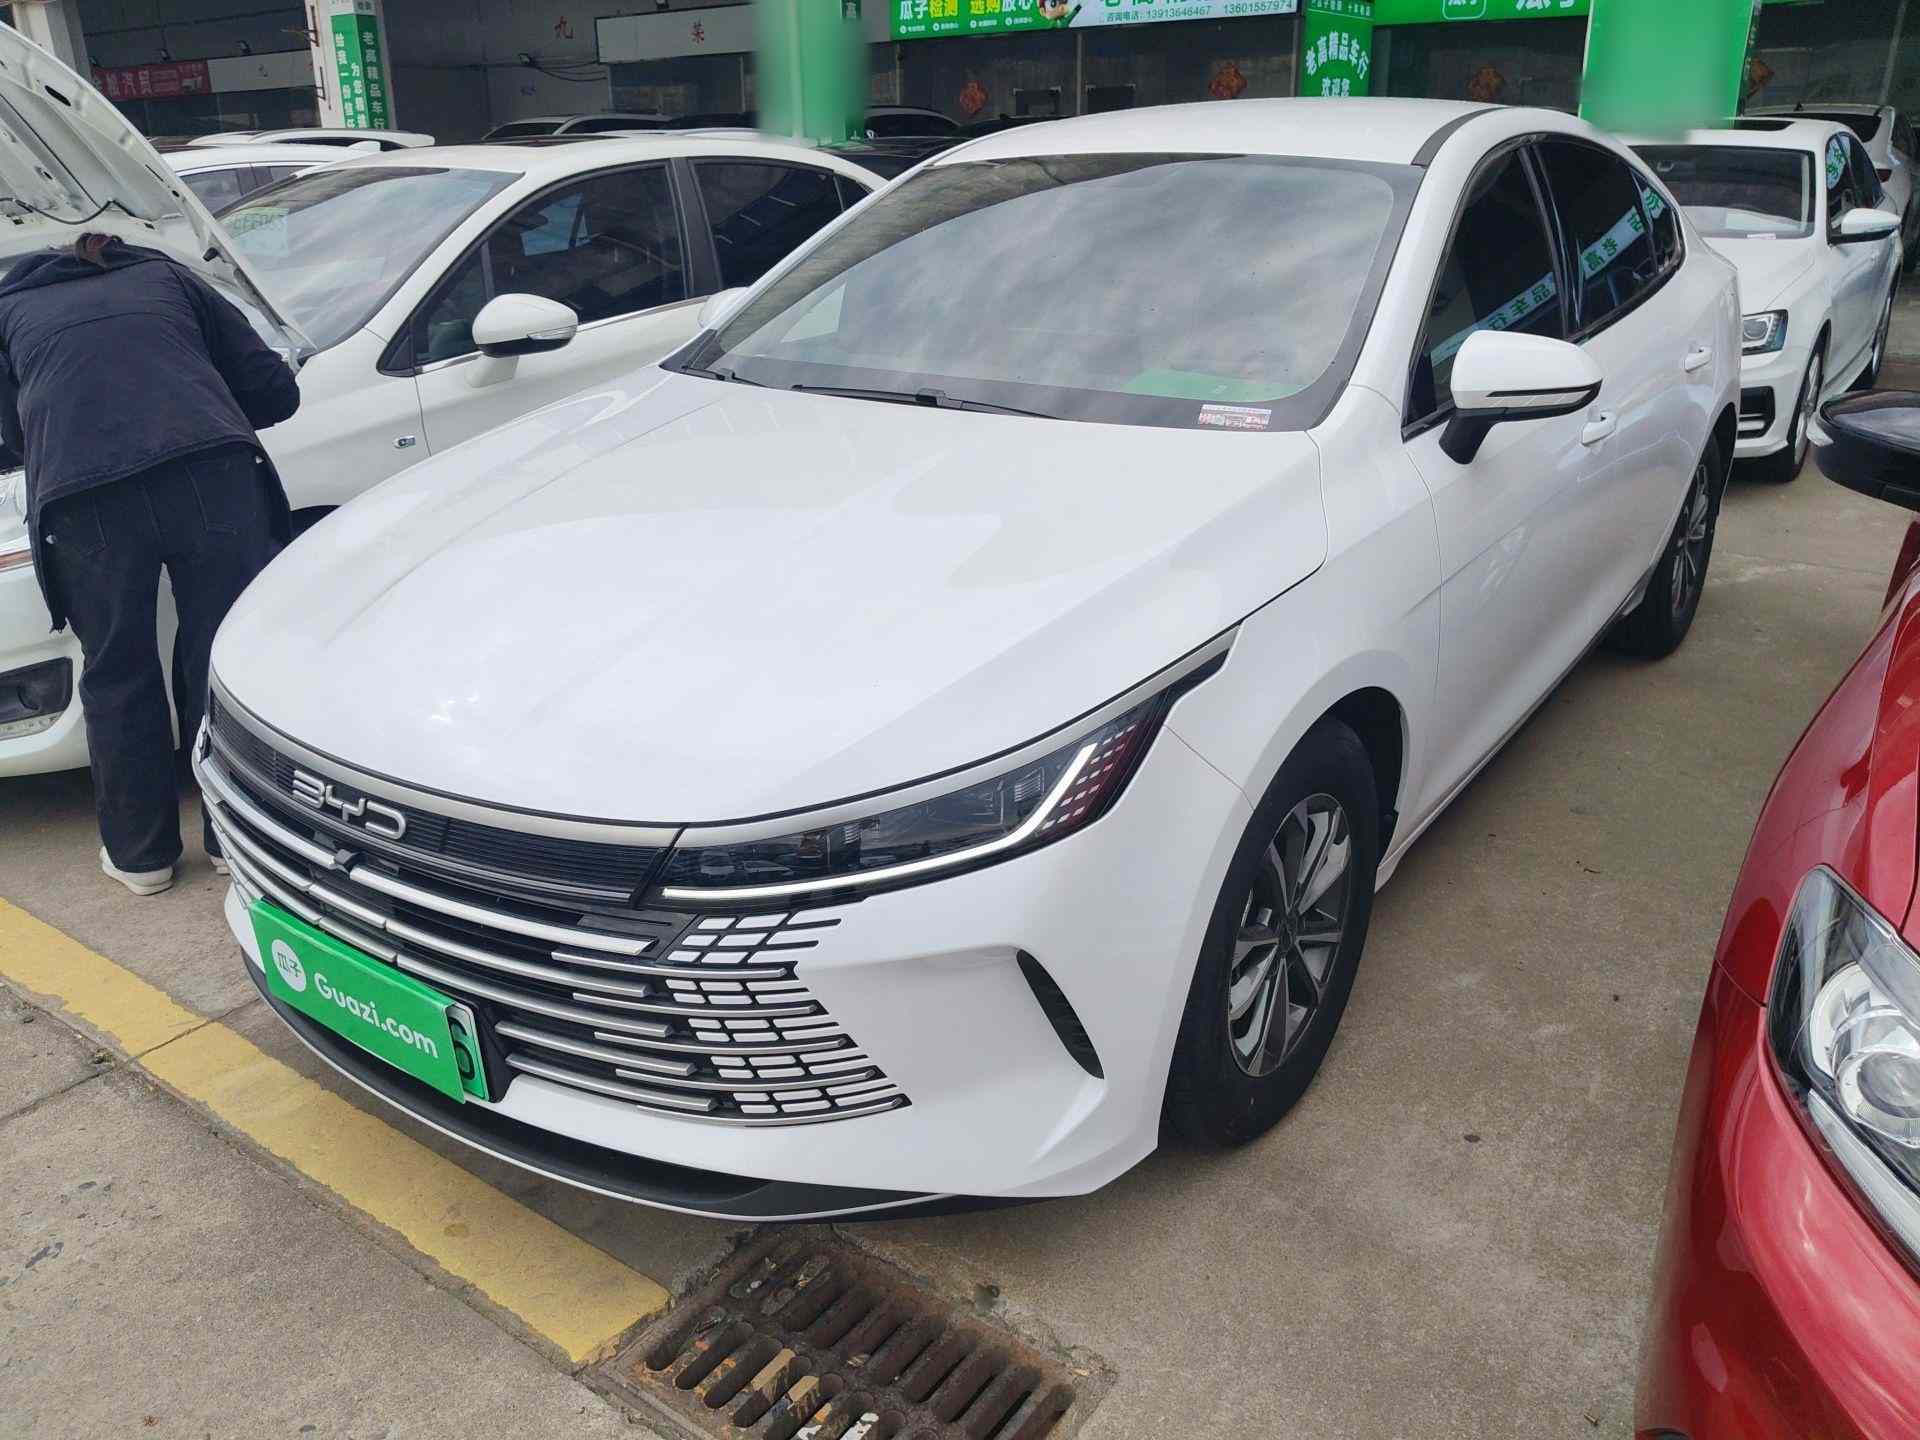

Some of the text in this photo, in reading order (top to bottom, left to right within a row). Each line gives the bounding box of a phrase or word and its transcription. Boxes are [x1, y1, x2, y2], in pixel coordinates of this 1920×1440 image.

[1306, 31, 1370, 80] 老高精品车行
[293, 769, 406, 840] BYD
[314, 972, 438, 1058] Guazi.com
